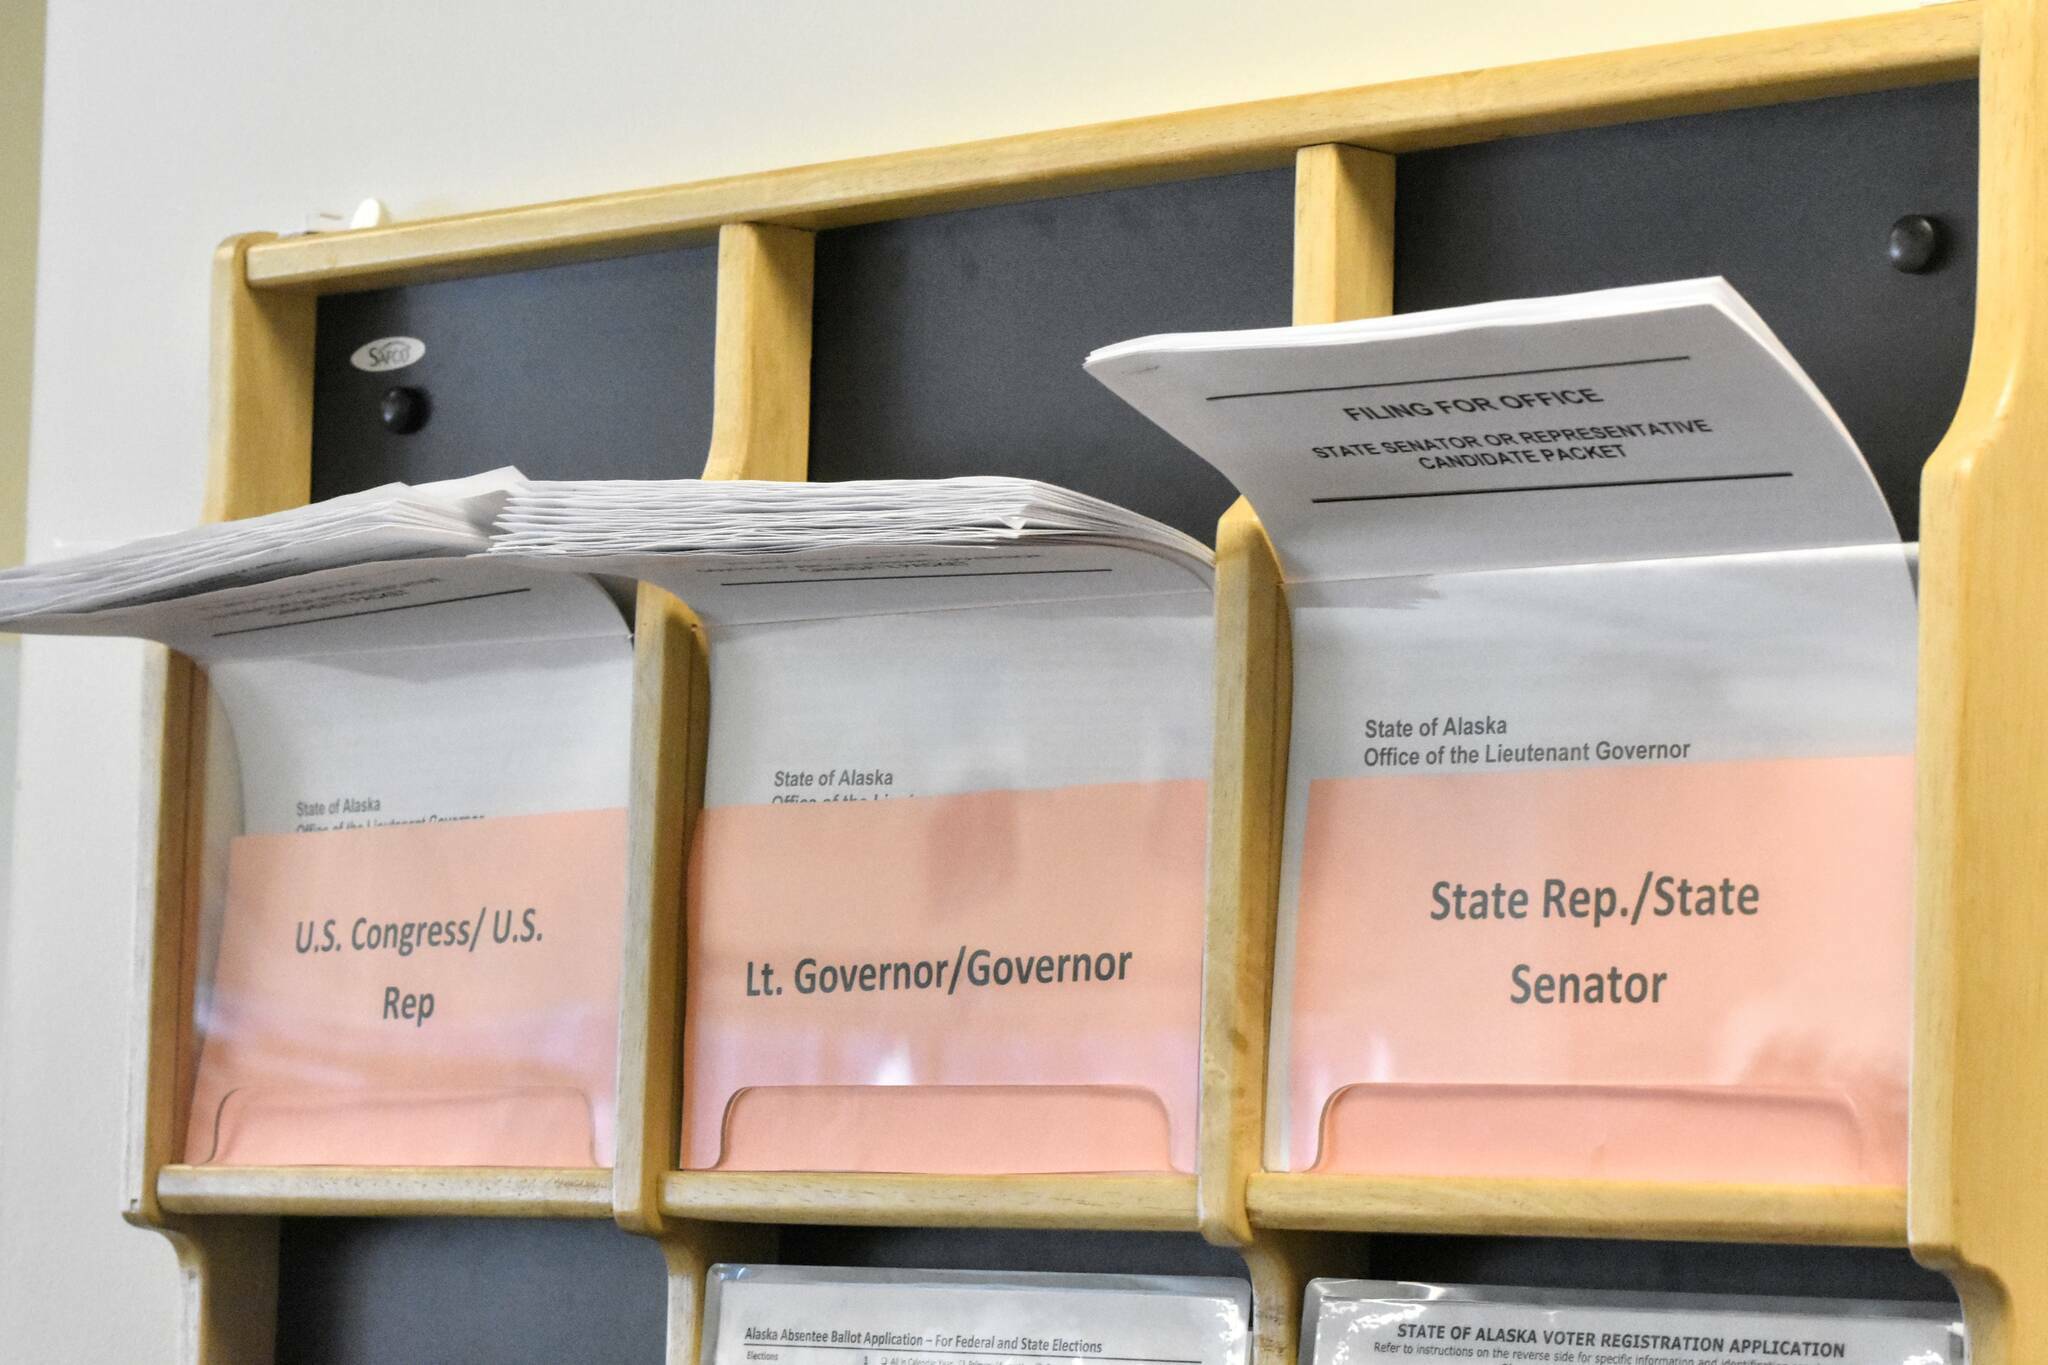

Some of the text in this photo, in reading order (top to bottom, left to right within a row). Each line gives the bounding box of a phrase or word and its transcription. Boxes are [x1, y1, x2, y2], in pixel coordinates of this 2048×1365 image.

[1344, 388, 1604, 422] FILING FOR OFFICE
[1312, 418, 1713, 460] STATE SENATOR OR REPRESENTATIVE
[1418, 443, 1628, 470] CANDIDATE PACKET
[1365, 716, 1508, 738] State of Alaska
[1364, 740, 1691, 767] Office of the Lieutenant Governor
[774, 769, 894, 787] State of Alaska
[296, 798, 381, 817] State of Alaska
[1430, 871, 1760, 928] State Rep./State
[295, 906, 542, 957] U.S. Congress/ U.S.
[746, 945, 1132, 996] Lt. Governor/Governor
[1510, 963, 1668, 1004] Senator
[383, 986, 435, 1027] Rep
[744, 1327, 778, 1341] Alaska
[780, 1329, 828, 1343] Absentee
[831, 1330, 862, 1344] Ballot
[864, 1331, 923, 1347] Application
[935, 1334, 952, 1347] For
[955, 1335, 995, 1349] Federal
[998, 1336, 1018, 1350] and
[1021, 1337, 1049, 1351] State
[1052, 1338, 1103, 1353] Elections
[1374, 1342, 1400, 1353] Refer
[1403, 1344, 1413, 1354] to
[1416, 1343, 1474, 1357] instructions
[1477, 1349, 1490, 1358] on
[1492, 1347, 1509, 1359] the
[1512, 1350, 1550, 1361] reverse
[1553, 1350, 1574, 1362] side
[1577, 1351, 1592, 1363] for
[1595, 1353, 1633, 1365] specific
[1398, 1324, 1845, 1358] STATE OF ALASKA VOTER REGISTRATION APPLICATION
